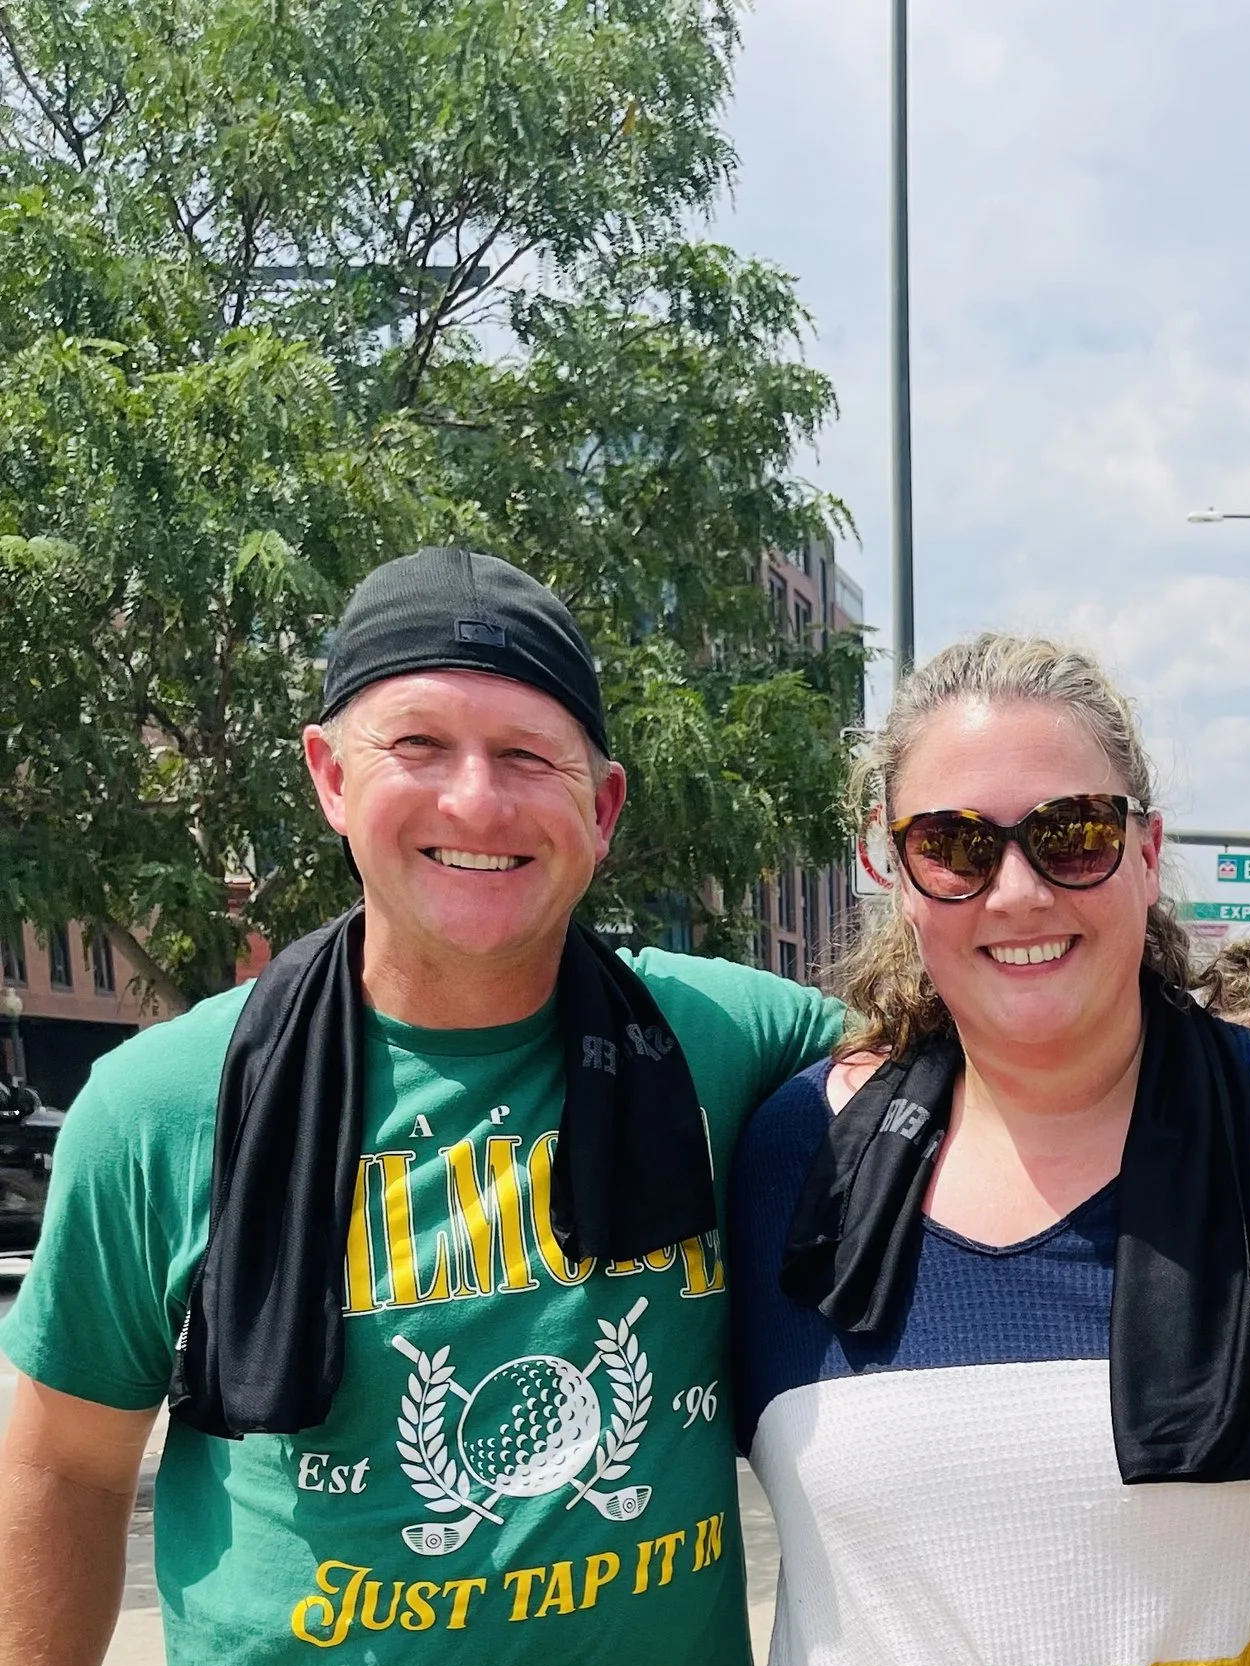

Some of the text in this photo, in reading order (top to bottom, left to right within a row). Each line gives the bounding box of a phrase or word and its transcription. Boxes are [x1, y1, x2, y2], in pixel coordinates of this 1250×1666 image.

[298, 1452, 371, 1494] Est
[503, 1552, 621, 1622] TAP
[631, 1530, 686, 1595] IT
[693, 1511, 726, 1572] IN
